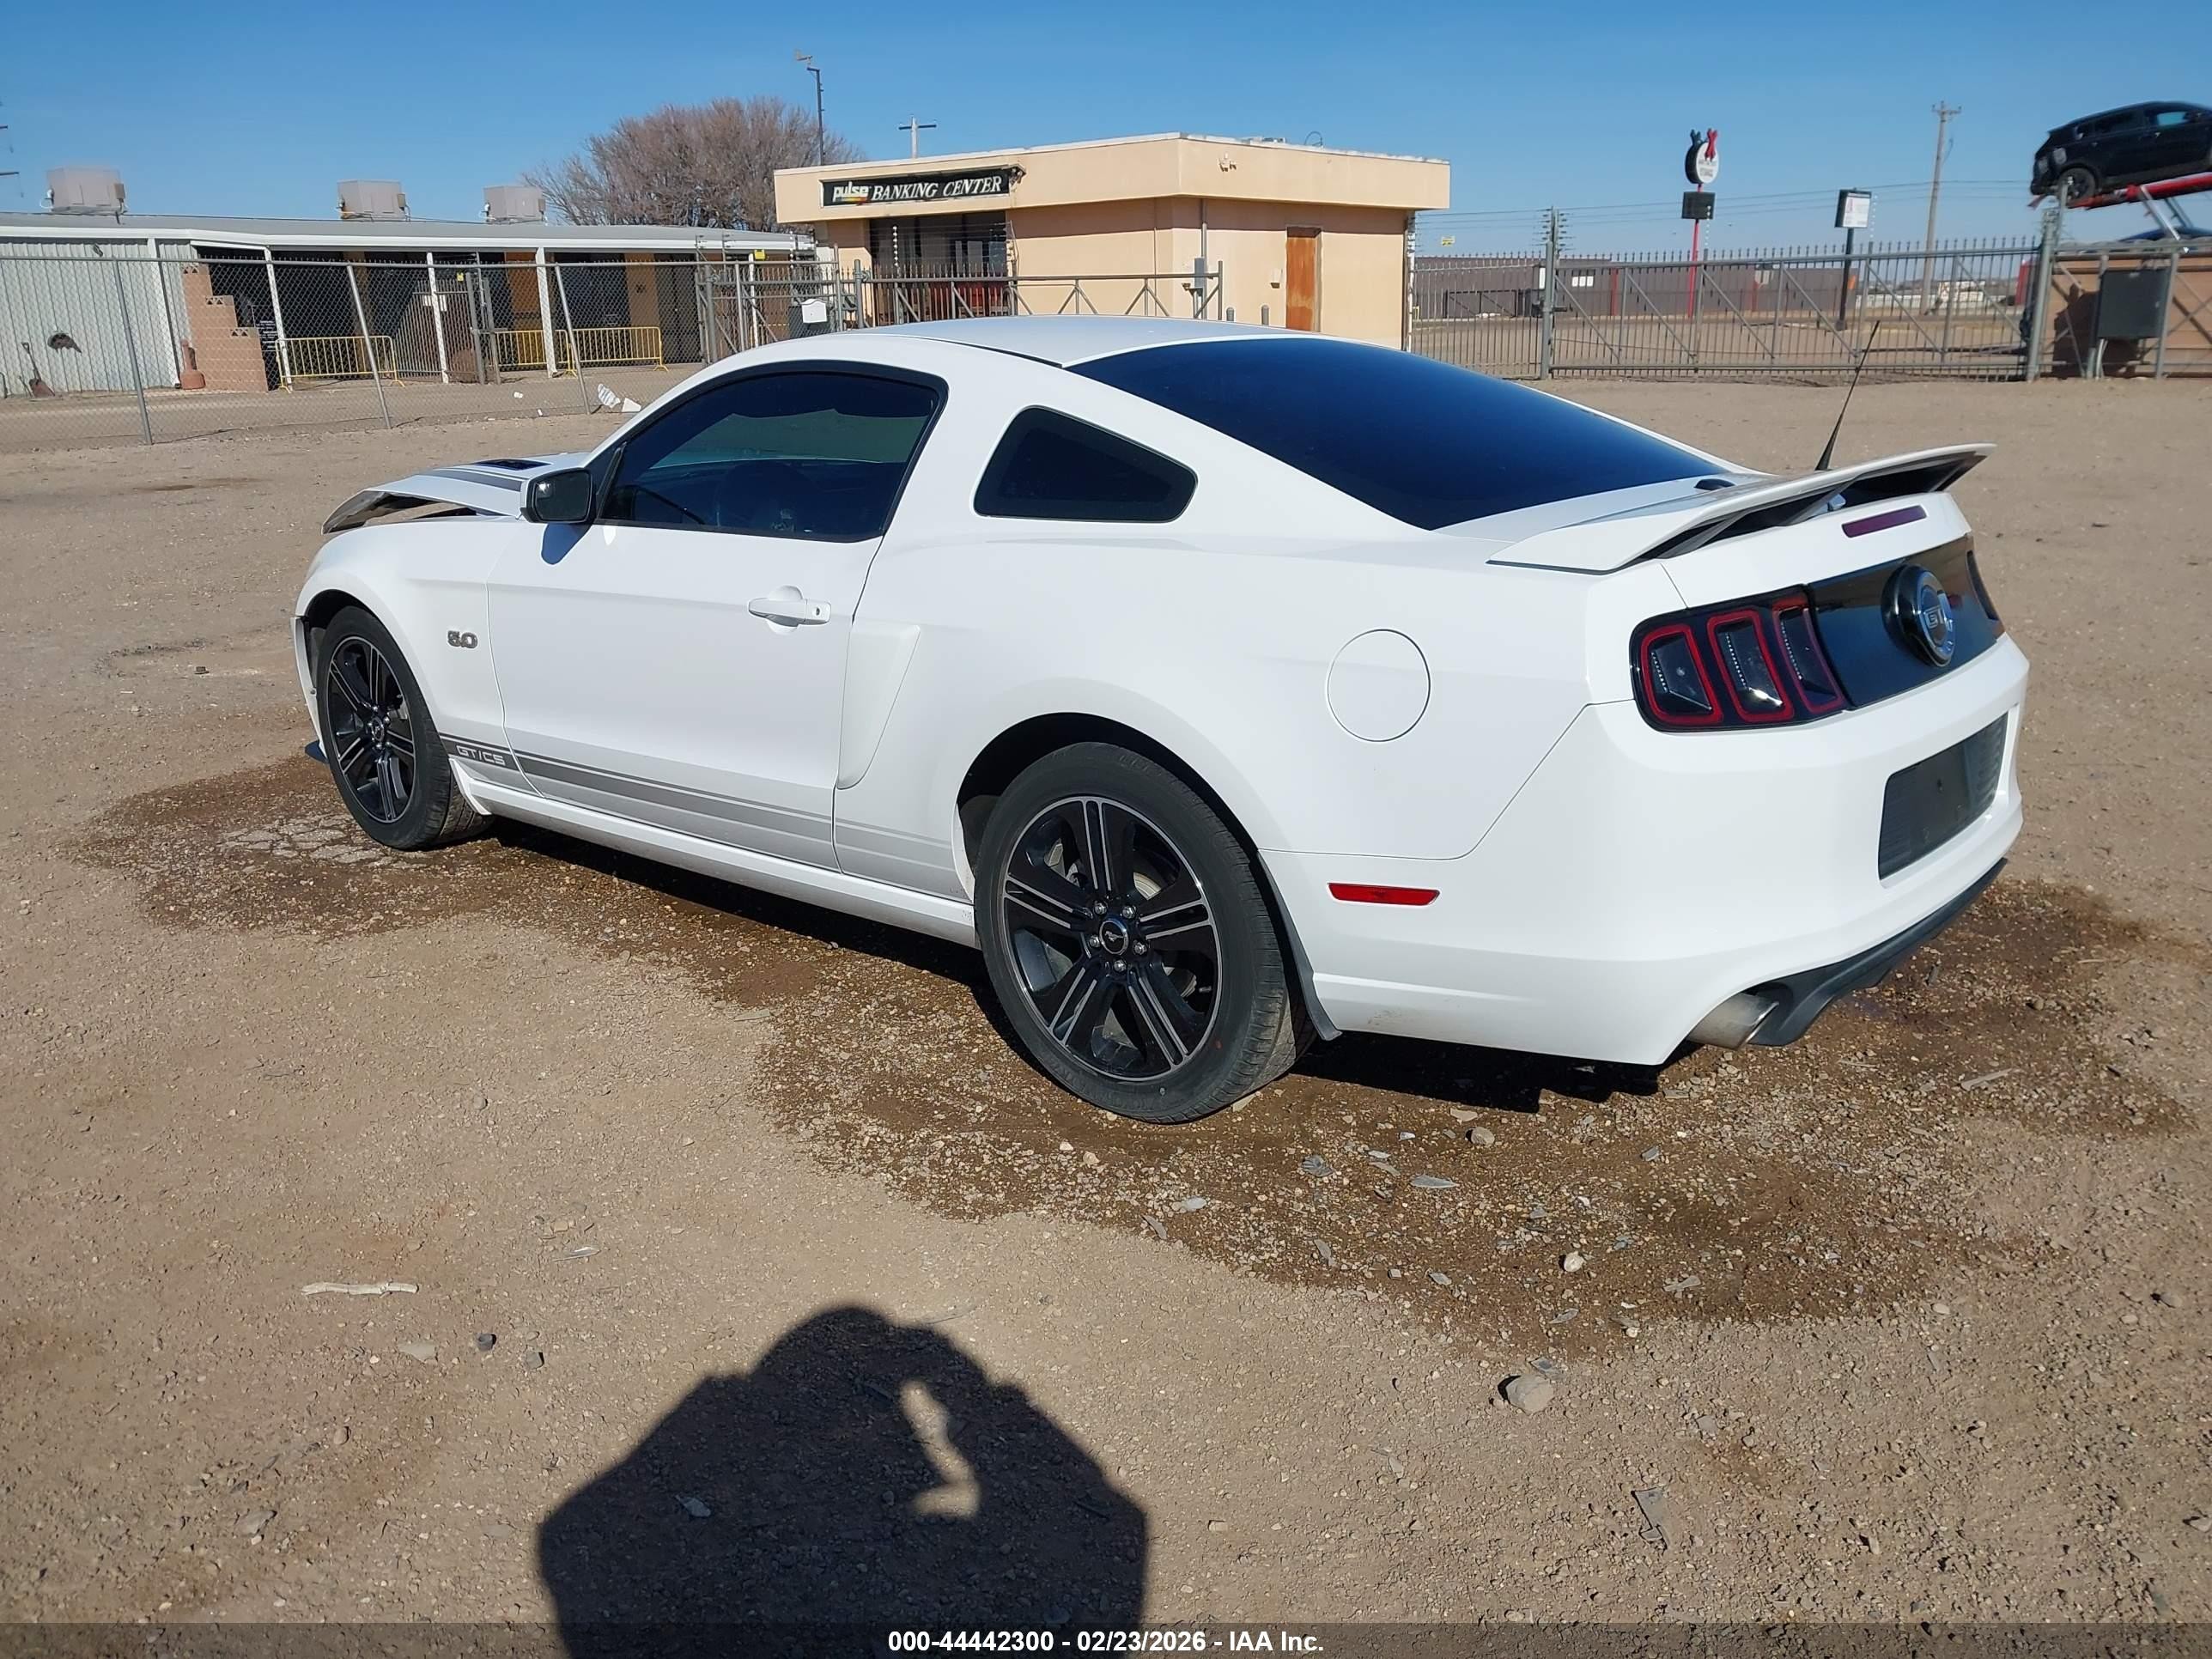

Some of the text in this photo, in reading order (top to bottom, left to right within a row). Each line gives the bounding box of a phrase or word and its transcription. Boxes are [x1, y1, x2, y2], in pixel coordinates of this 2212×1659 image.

[831, 175, 1002, 203] pulse BANKING CENTER
[456, 744, 507, 766] GT/CS
